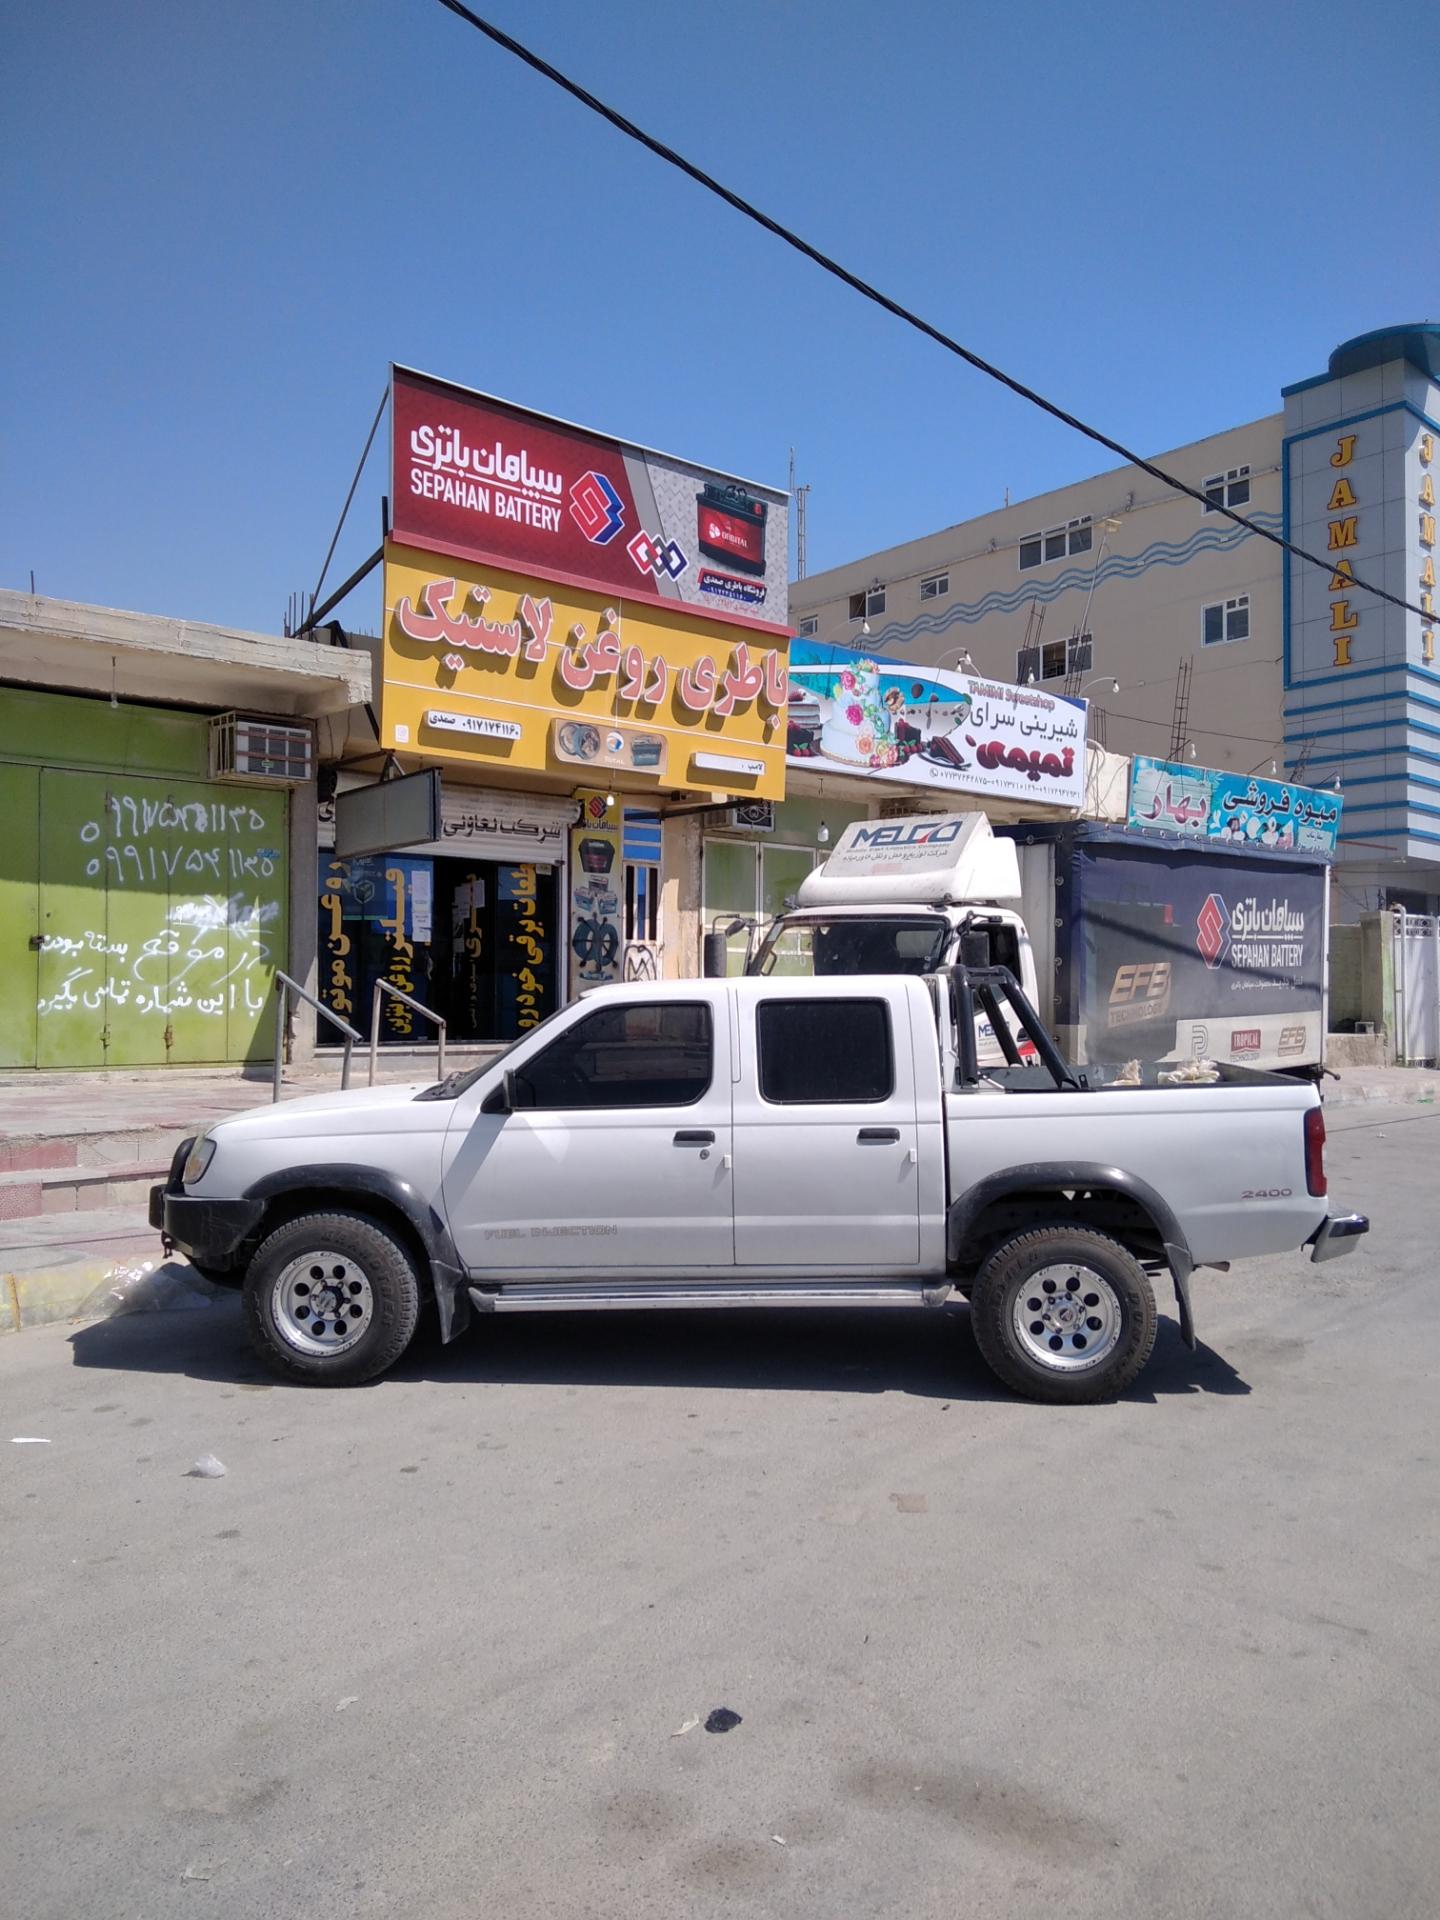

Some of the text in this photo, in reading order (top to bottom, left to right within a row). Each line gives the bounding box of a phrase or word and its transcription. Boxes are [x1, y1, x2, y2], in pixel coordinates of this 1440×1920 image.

[410, 425, 562, 499] سپاهان باتری
[410, 468, 562, 533] SEPAHAN BATTERY
[1327, 434, 1357, 667] JAMALI
[398, 577, 788, 731] باطری روغن لاستیک
[970, 702, 1078, 742] شیرینی سرای
[976, 741, 1075, 782] تمیمی
[1143, 781, 1338, 828] میوه فروشی بهار
[850, 821, 963, 849] MELCO
[321, 861, 352, 956] روغن
[379, 868, 414, 959] فیلتر
[1231, 898, 1261, 941] باتری
[509, 919, 544, 965] برقی
[1231, 943, 1303, 968] SEPAHAN BATTERY
[84, 977, 131, 1008] تماس
[136, 981, 193, 1014] شماره
[245, 978, 263, 1017] با
[1109, 963, 1171, 1004] EFB
[1233, 1032, 1259, 1048] TROPICAL
[1242, 1188, 1293, 1199] 2400
